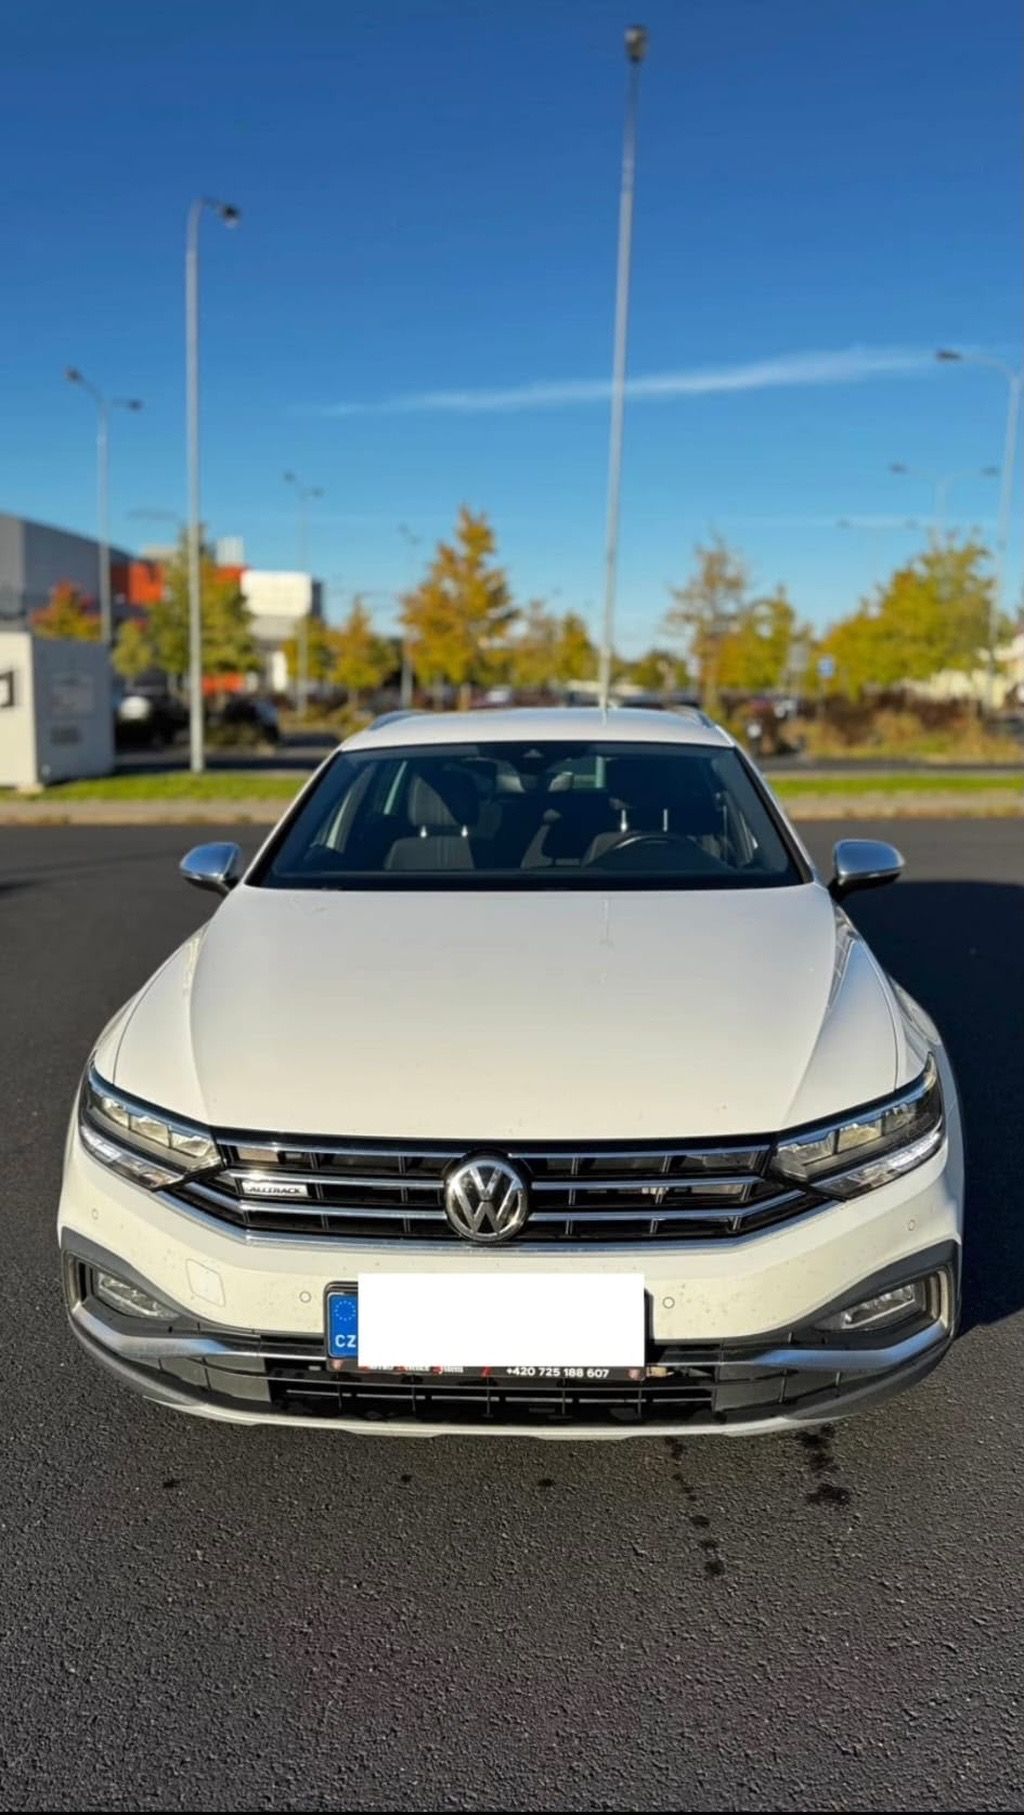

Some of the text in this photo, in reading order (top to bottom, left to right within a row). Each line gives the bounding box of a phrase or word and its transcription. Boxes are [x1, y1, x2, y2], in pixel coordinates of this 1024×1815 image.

[447, 1160, 527, 1241] VW
[335, 1334, 357, 1348] CZ
[506, 1366, 609, 1378] +420 725 188 607
